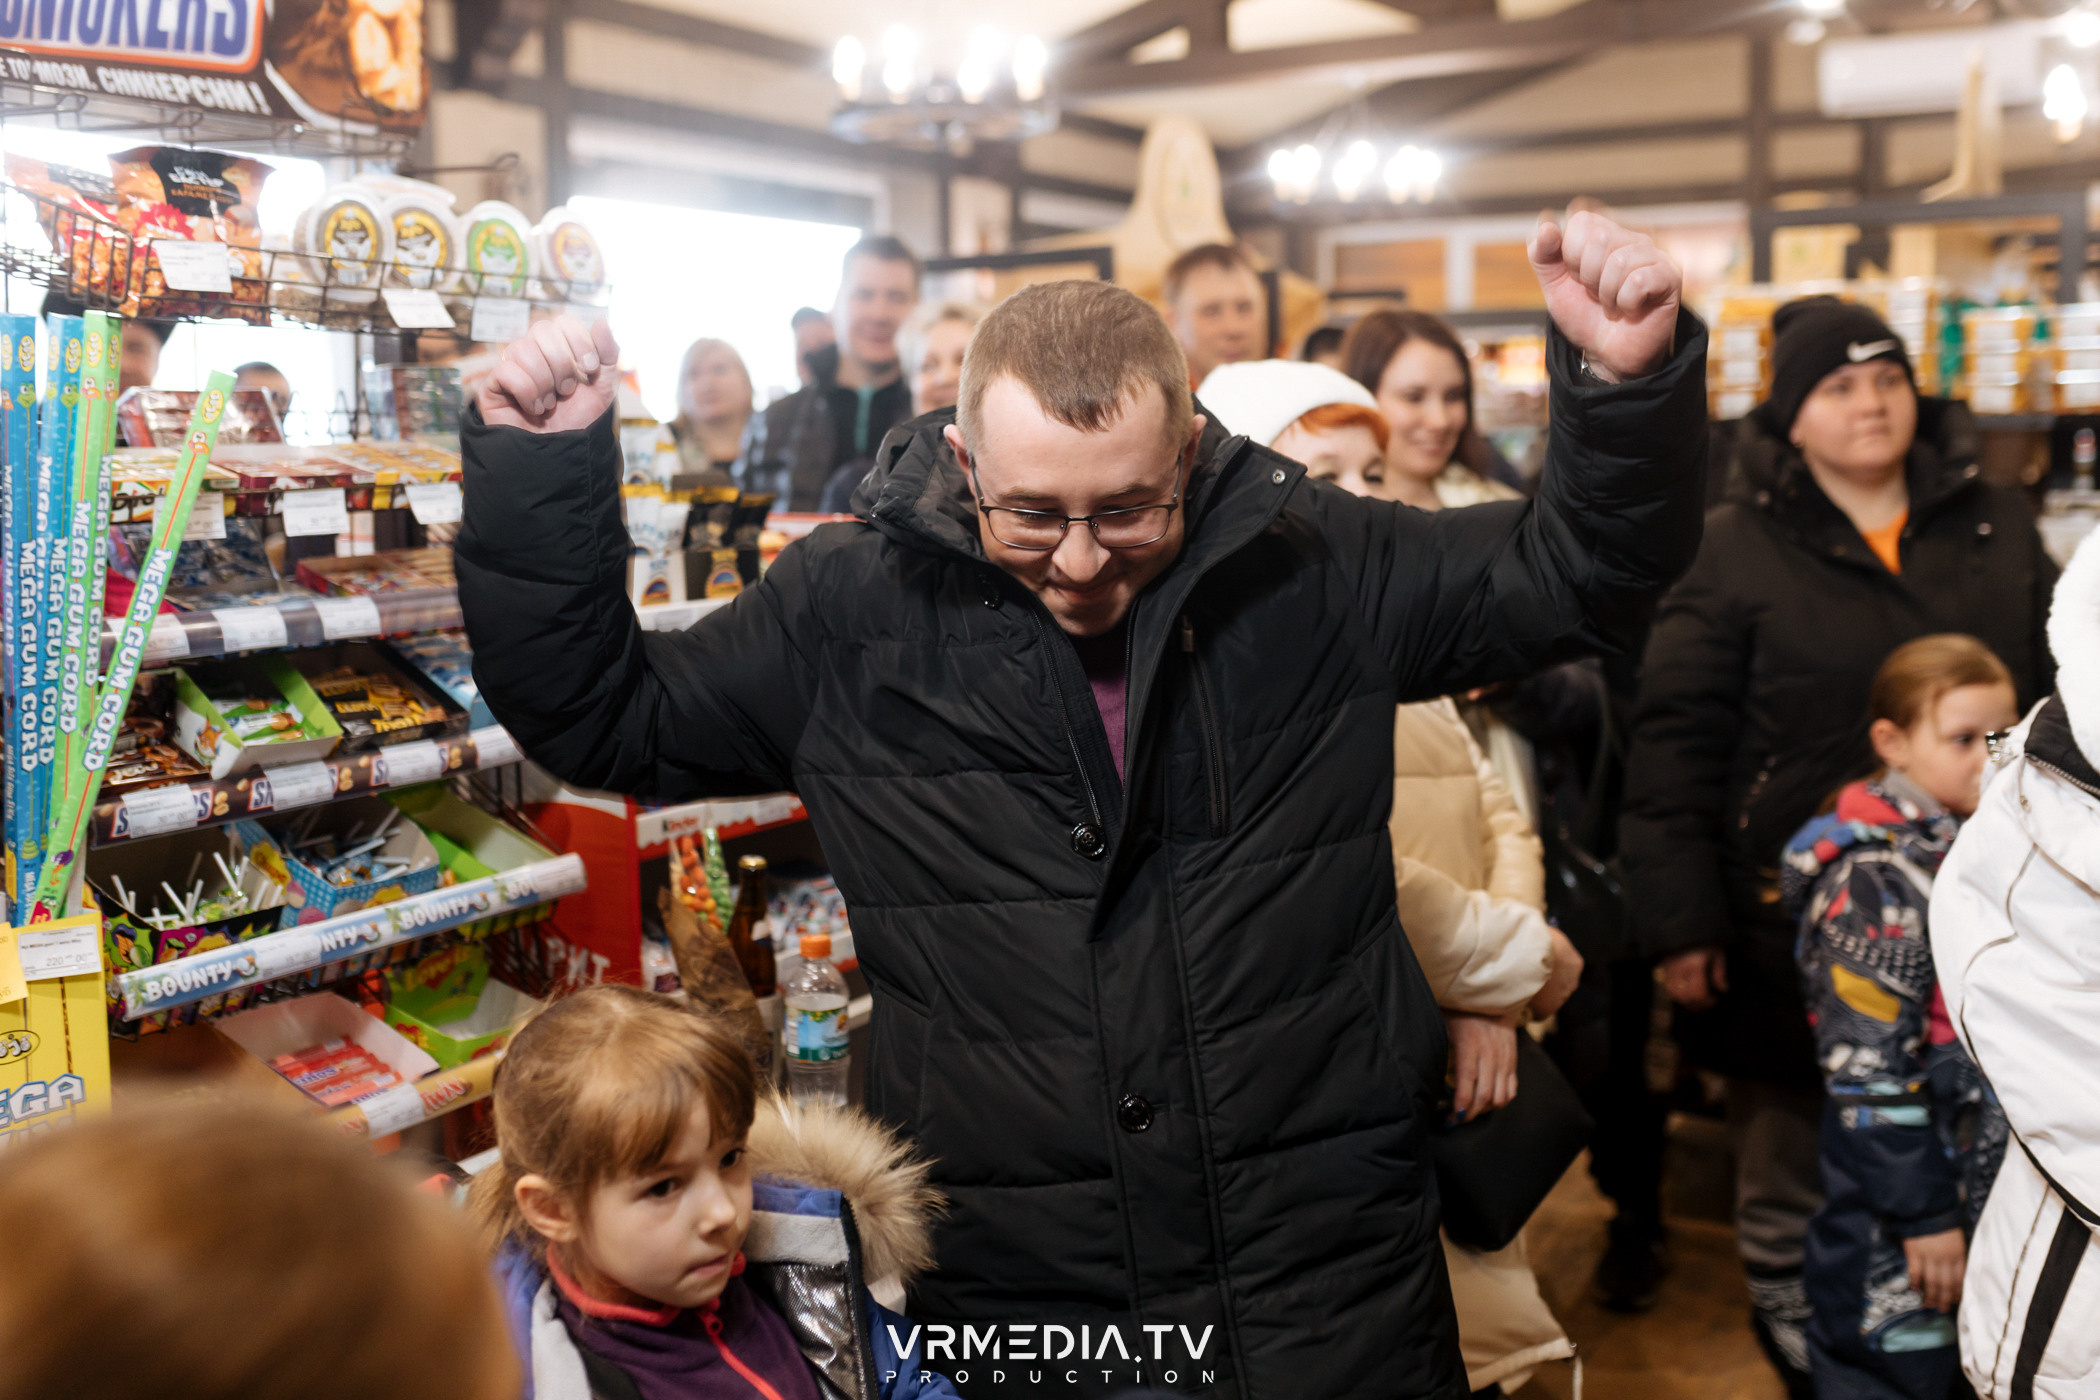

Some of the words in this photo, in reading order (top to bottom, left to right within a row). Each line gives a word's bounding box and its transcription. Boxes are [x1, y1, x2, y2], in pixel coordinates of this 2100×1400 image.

[7, 58, 98, 91] ТОМОЗИ.
[97, 67, 272, 116] СНИКЕРСНИ!
[37, 455, 52, 532] MEGA
[96, 454, 113, 532] MEGA
[48, 536, 68, 613] MEGA
[69, 501, 92, 579] MEGA
[90, 536, 106, 601] GUM
[19, 539, 37, 619] MEGA
[64, 582, 86, 649] GUM
[132, 547, 173, 623] MEGA
[20, 622, 38, 687] GUM
[43, 617, 63, 681] GUM
[85, 605, 102, 688] CORD
[108, 625, 145, 690] GUM
[39, 686, 58, 765] CORD
[59, 652, 81, 734] CORD
[21, 692, 38, 772] CORD
[83, 693, 123, 772] CORD
[319, 925, 358, 953] NTY
[399, 895, 470, 931] BOUNTY
[145, 959, 232, 1001] BOUNTY
